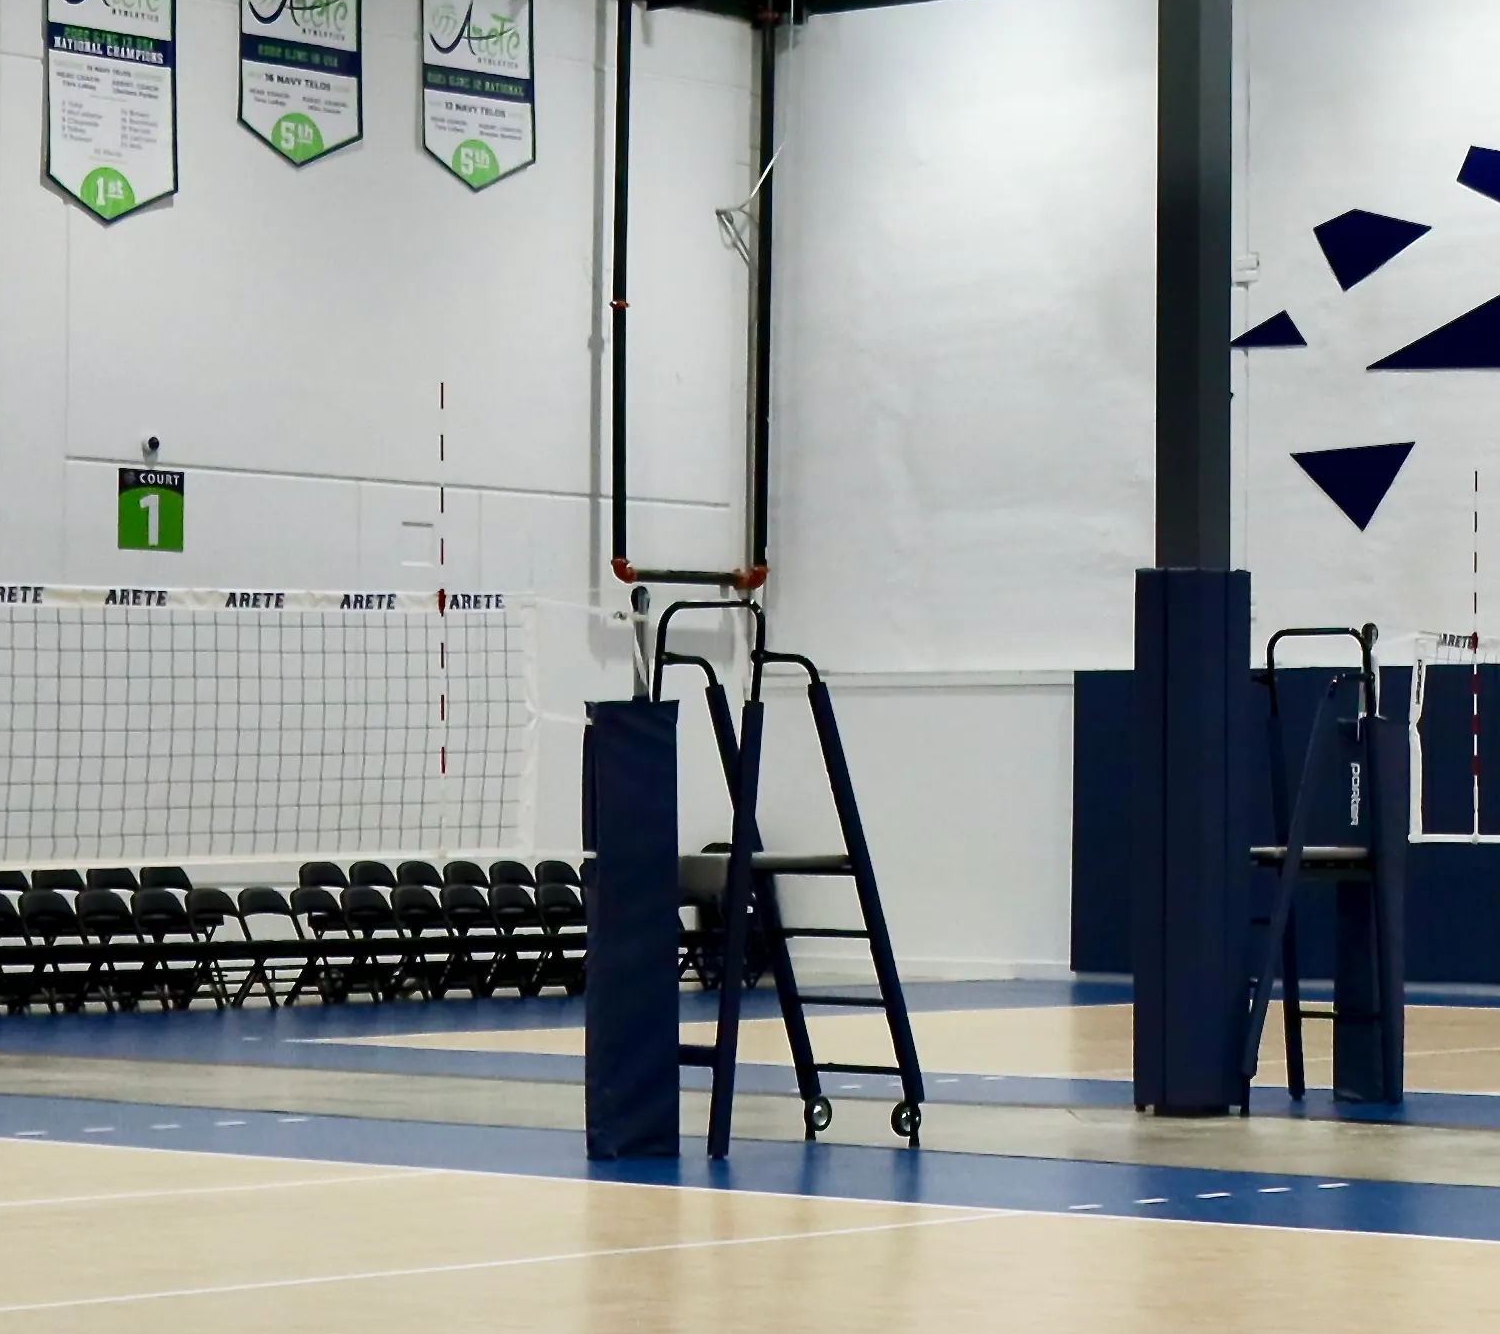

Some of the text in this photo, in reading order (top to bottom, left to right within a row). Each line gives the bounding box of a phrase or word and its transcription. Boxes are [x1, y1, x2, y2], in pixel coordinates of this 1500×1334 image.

[54, 36, 164, 64] NATIONAL CHAMPIONS
[277, 74, 302, 86] NAVY
[305, 79, 331, 91] TELOS
[96, 176, 125, 206] 1st
[139, 473, 180, 486] COURT
[139, 494, 159, 546] 1
[104, 588, 168, 607] ARETE
[224, 591, 285, 609] ARETE
[339, 593, 396, 610] ARETE
[449, 592, 504, 610] ARETE
